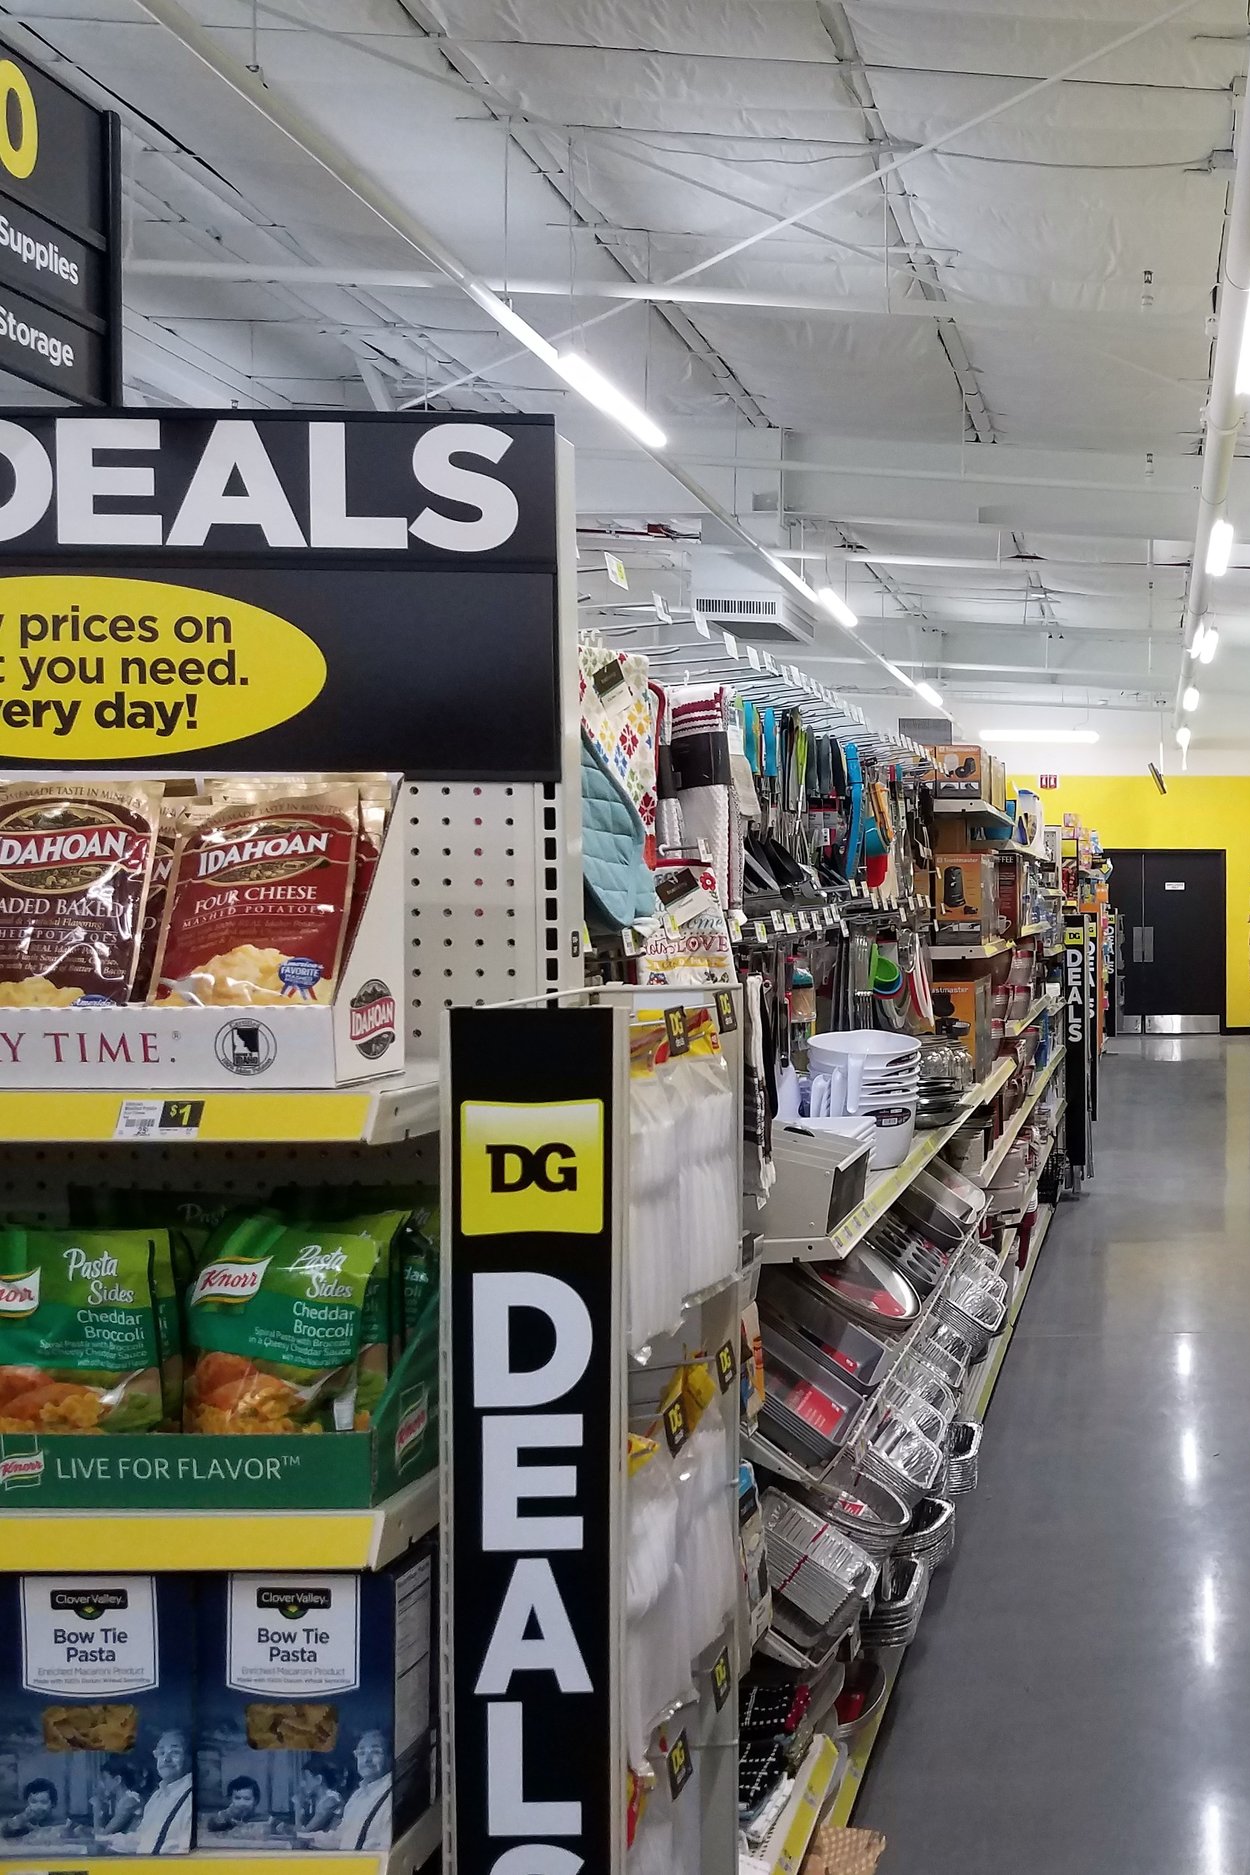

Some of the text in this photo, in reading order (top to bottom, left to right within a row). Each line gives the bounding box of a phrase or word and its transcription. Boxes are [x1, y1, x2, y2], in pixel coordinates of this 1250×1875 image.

[0, 215, 80, 286] Supplies
[0, 307, 75, 368] Storage
[20, 605, 159, 647] prices
[173, 612, 232, 643] on
[20, 655, 104, 691] you
[121, 651, 249, 686] need.
[95, 692, 199, 737] day!
[0, 831, 128, 865] DAHOAN
[197, 831, 328, 877] IDAHOAN
[194, 885, 317, 915] FOUR CHEESE
[1069, 932, 1080, 940] DG
[280, 967, 320, 978] FAVORITE
[1066, 949, 1083, 1043] DEALS
[350, 999, 395, 1038] IDAHOAN
[169, 1104, 191, 1127] $1
[486, 1143, 578, 1192] DG
[62, 1247, 119, 1281] Pasta
[287, 1245, 349, 1275] Pasta
[201, 1267, 259, 1289] Knorr
[306, 1275, 353, 1299] Sides
[87, 1280, 136, 1305] Sides
[76, 1309, 144, 1326] Cheddar
[293, 1301, 355, 1321] Cheddar
[84, 1325, 146, 1342] Broccoli
[293, 1319, 354, 1338] Broccoli
[0, 1459, 43, 1476] Knorr
[57, 1457, 113, 1480] LIVE
[119, 1457, 170, 1479] FOR
[472, 1272, 594, 1875] DEAL
[56, 1593, 89, 1604] Clover
[53, 1628, 128, 1645] Bow Tie
[257, 1628, 330, 1644] Bow Tie
[66, 1647, 116, 1663] Pasta
[269, 1647, 318, 1663] Pasta
